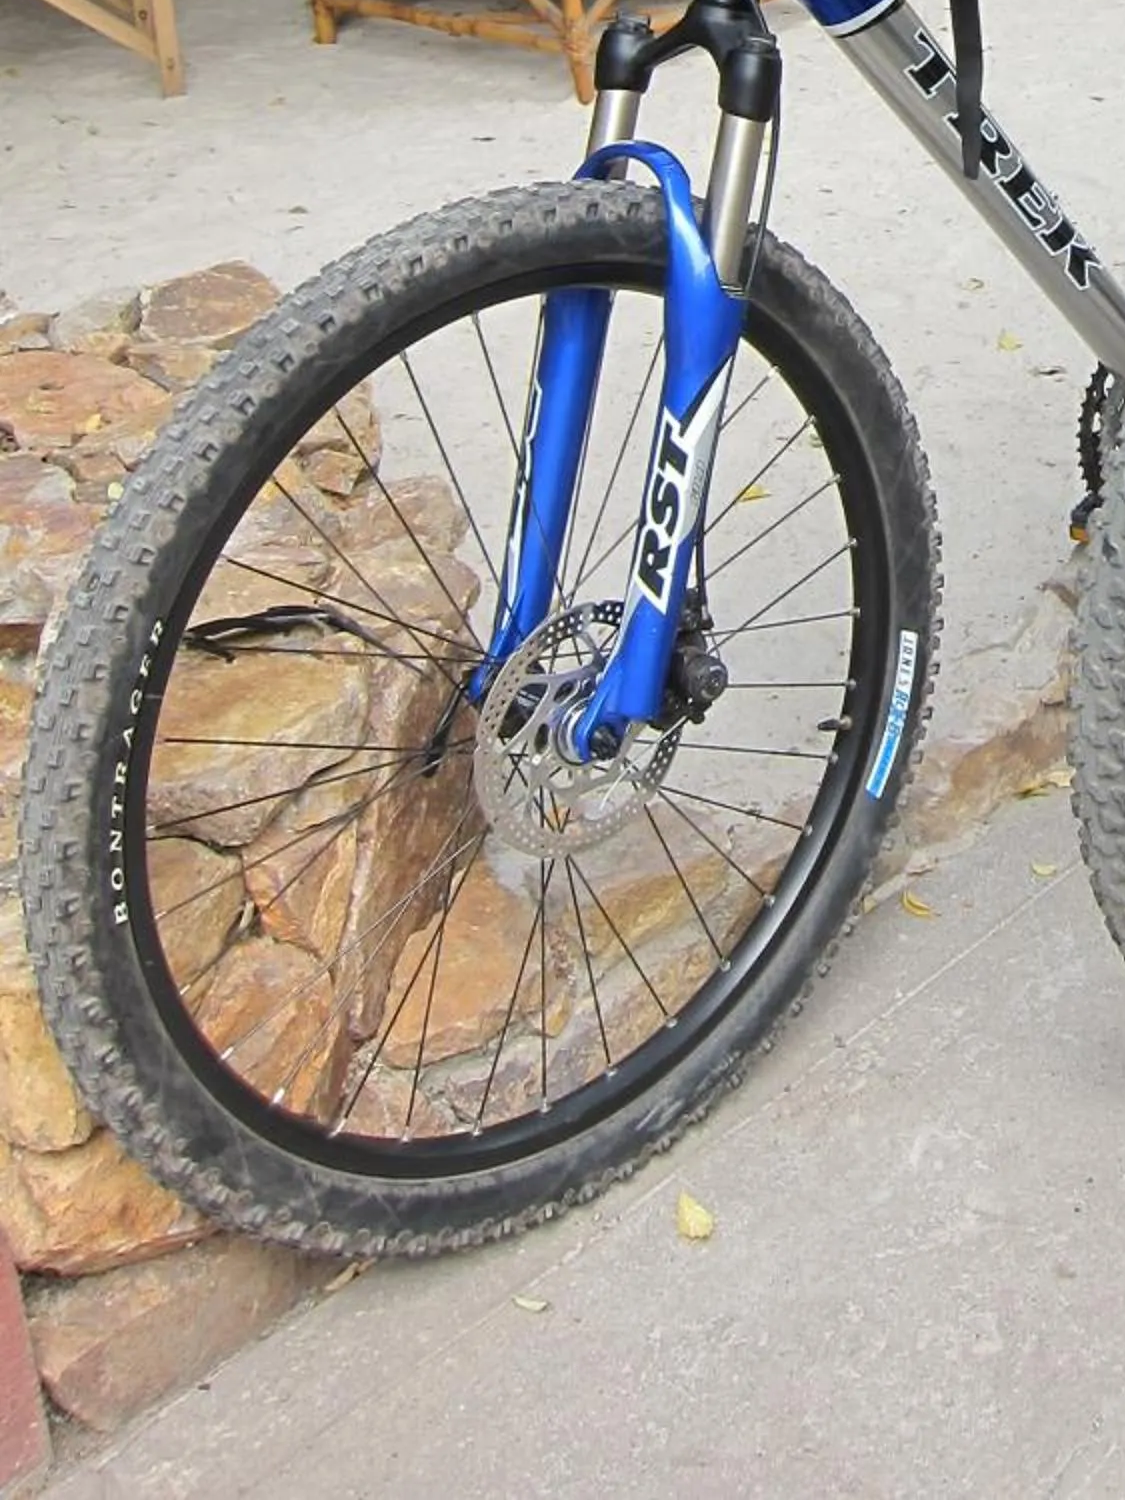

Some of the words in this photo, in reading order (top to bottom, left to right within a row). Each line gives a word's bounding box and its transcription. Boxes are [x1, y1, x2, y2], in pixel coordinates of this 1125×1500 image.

[904, 26, 1103, 292] TREK
[637, 418, 690, 600] RST
[111, 618, 167, 927] BONTRAGER
